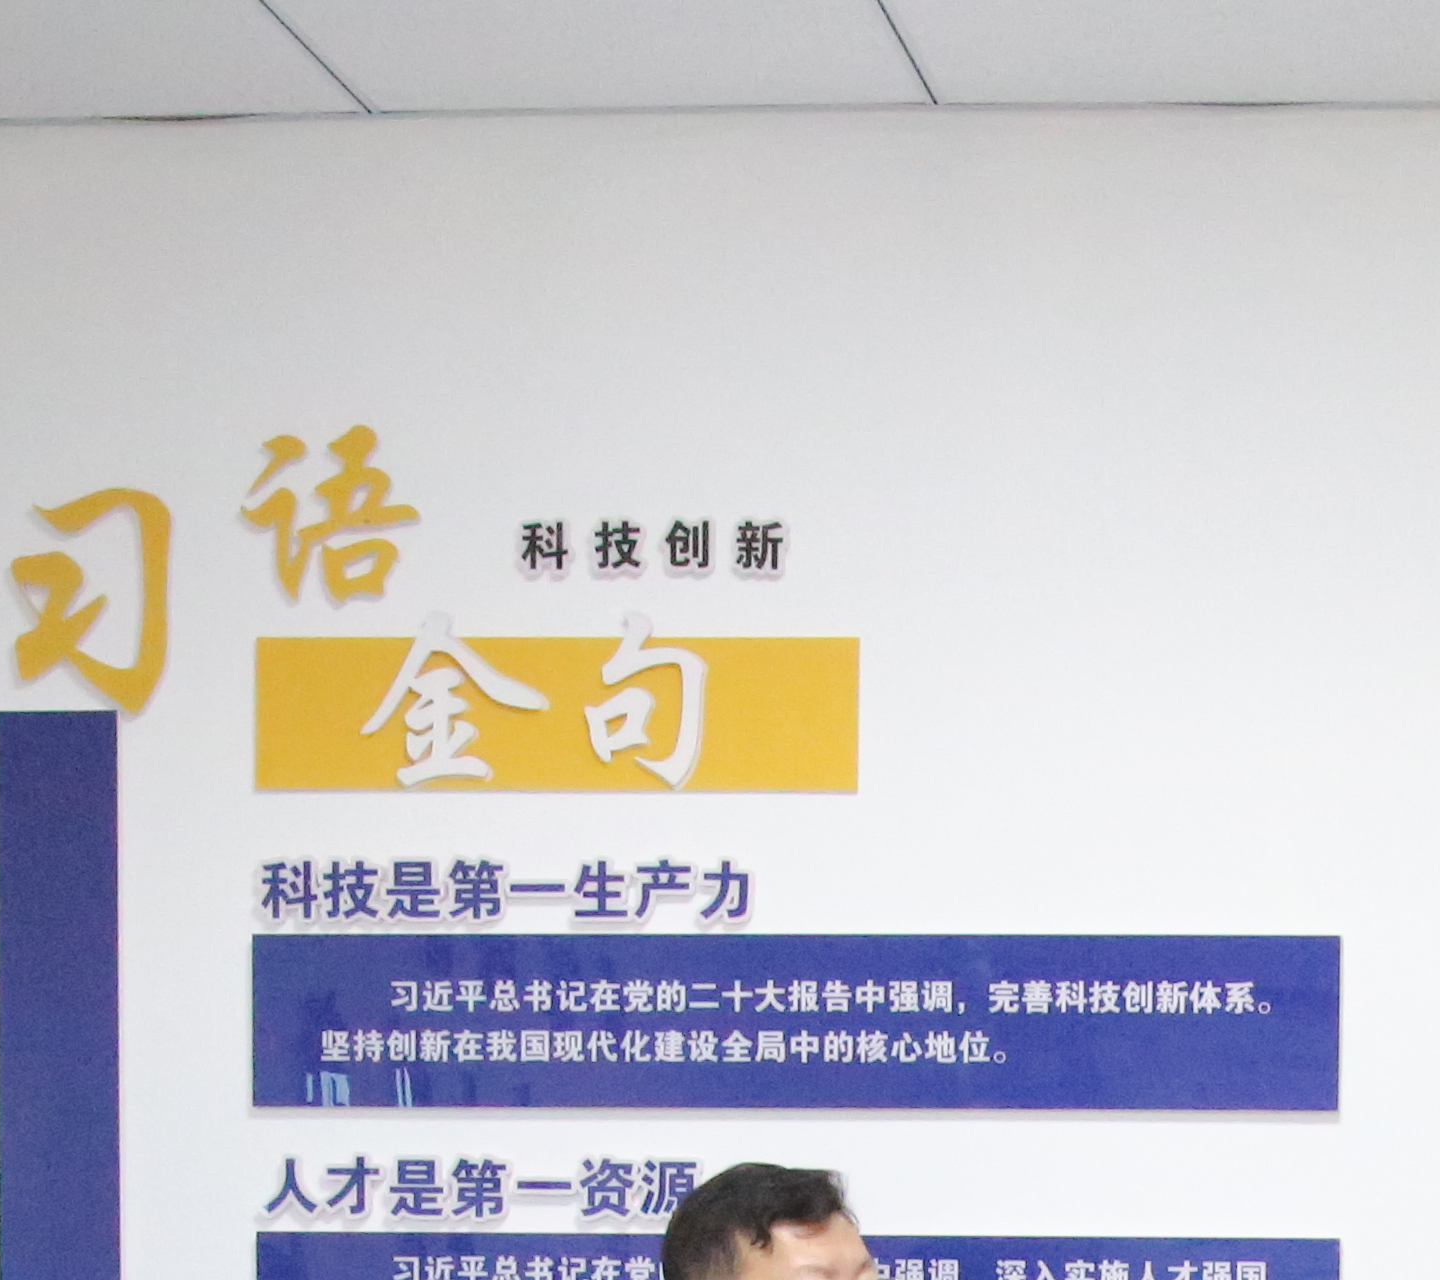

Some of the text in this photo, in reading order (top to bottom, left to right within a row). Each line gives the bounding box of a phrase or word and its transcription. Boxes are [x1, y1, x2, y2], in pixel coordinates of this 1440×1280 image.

[517, 518, 788, 573] 科技创新
[360, 609, 708, 791] 金句
[260, 858, 754, 922] 科技是第一生产力
[389, 977, 1276, 1017] 习近平总书记在党的二十大报告中强调，完善科技创新体系。
[320, 1028, 1008, 1065] 坚持创新在我国现代化建设全局中的核心地位。
[265, 1157, 698, 1217] 人才是第一资源
